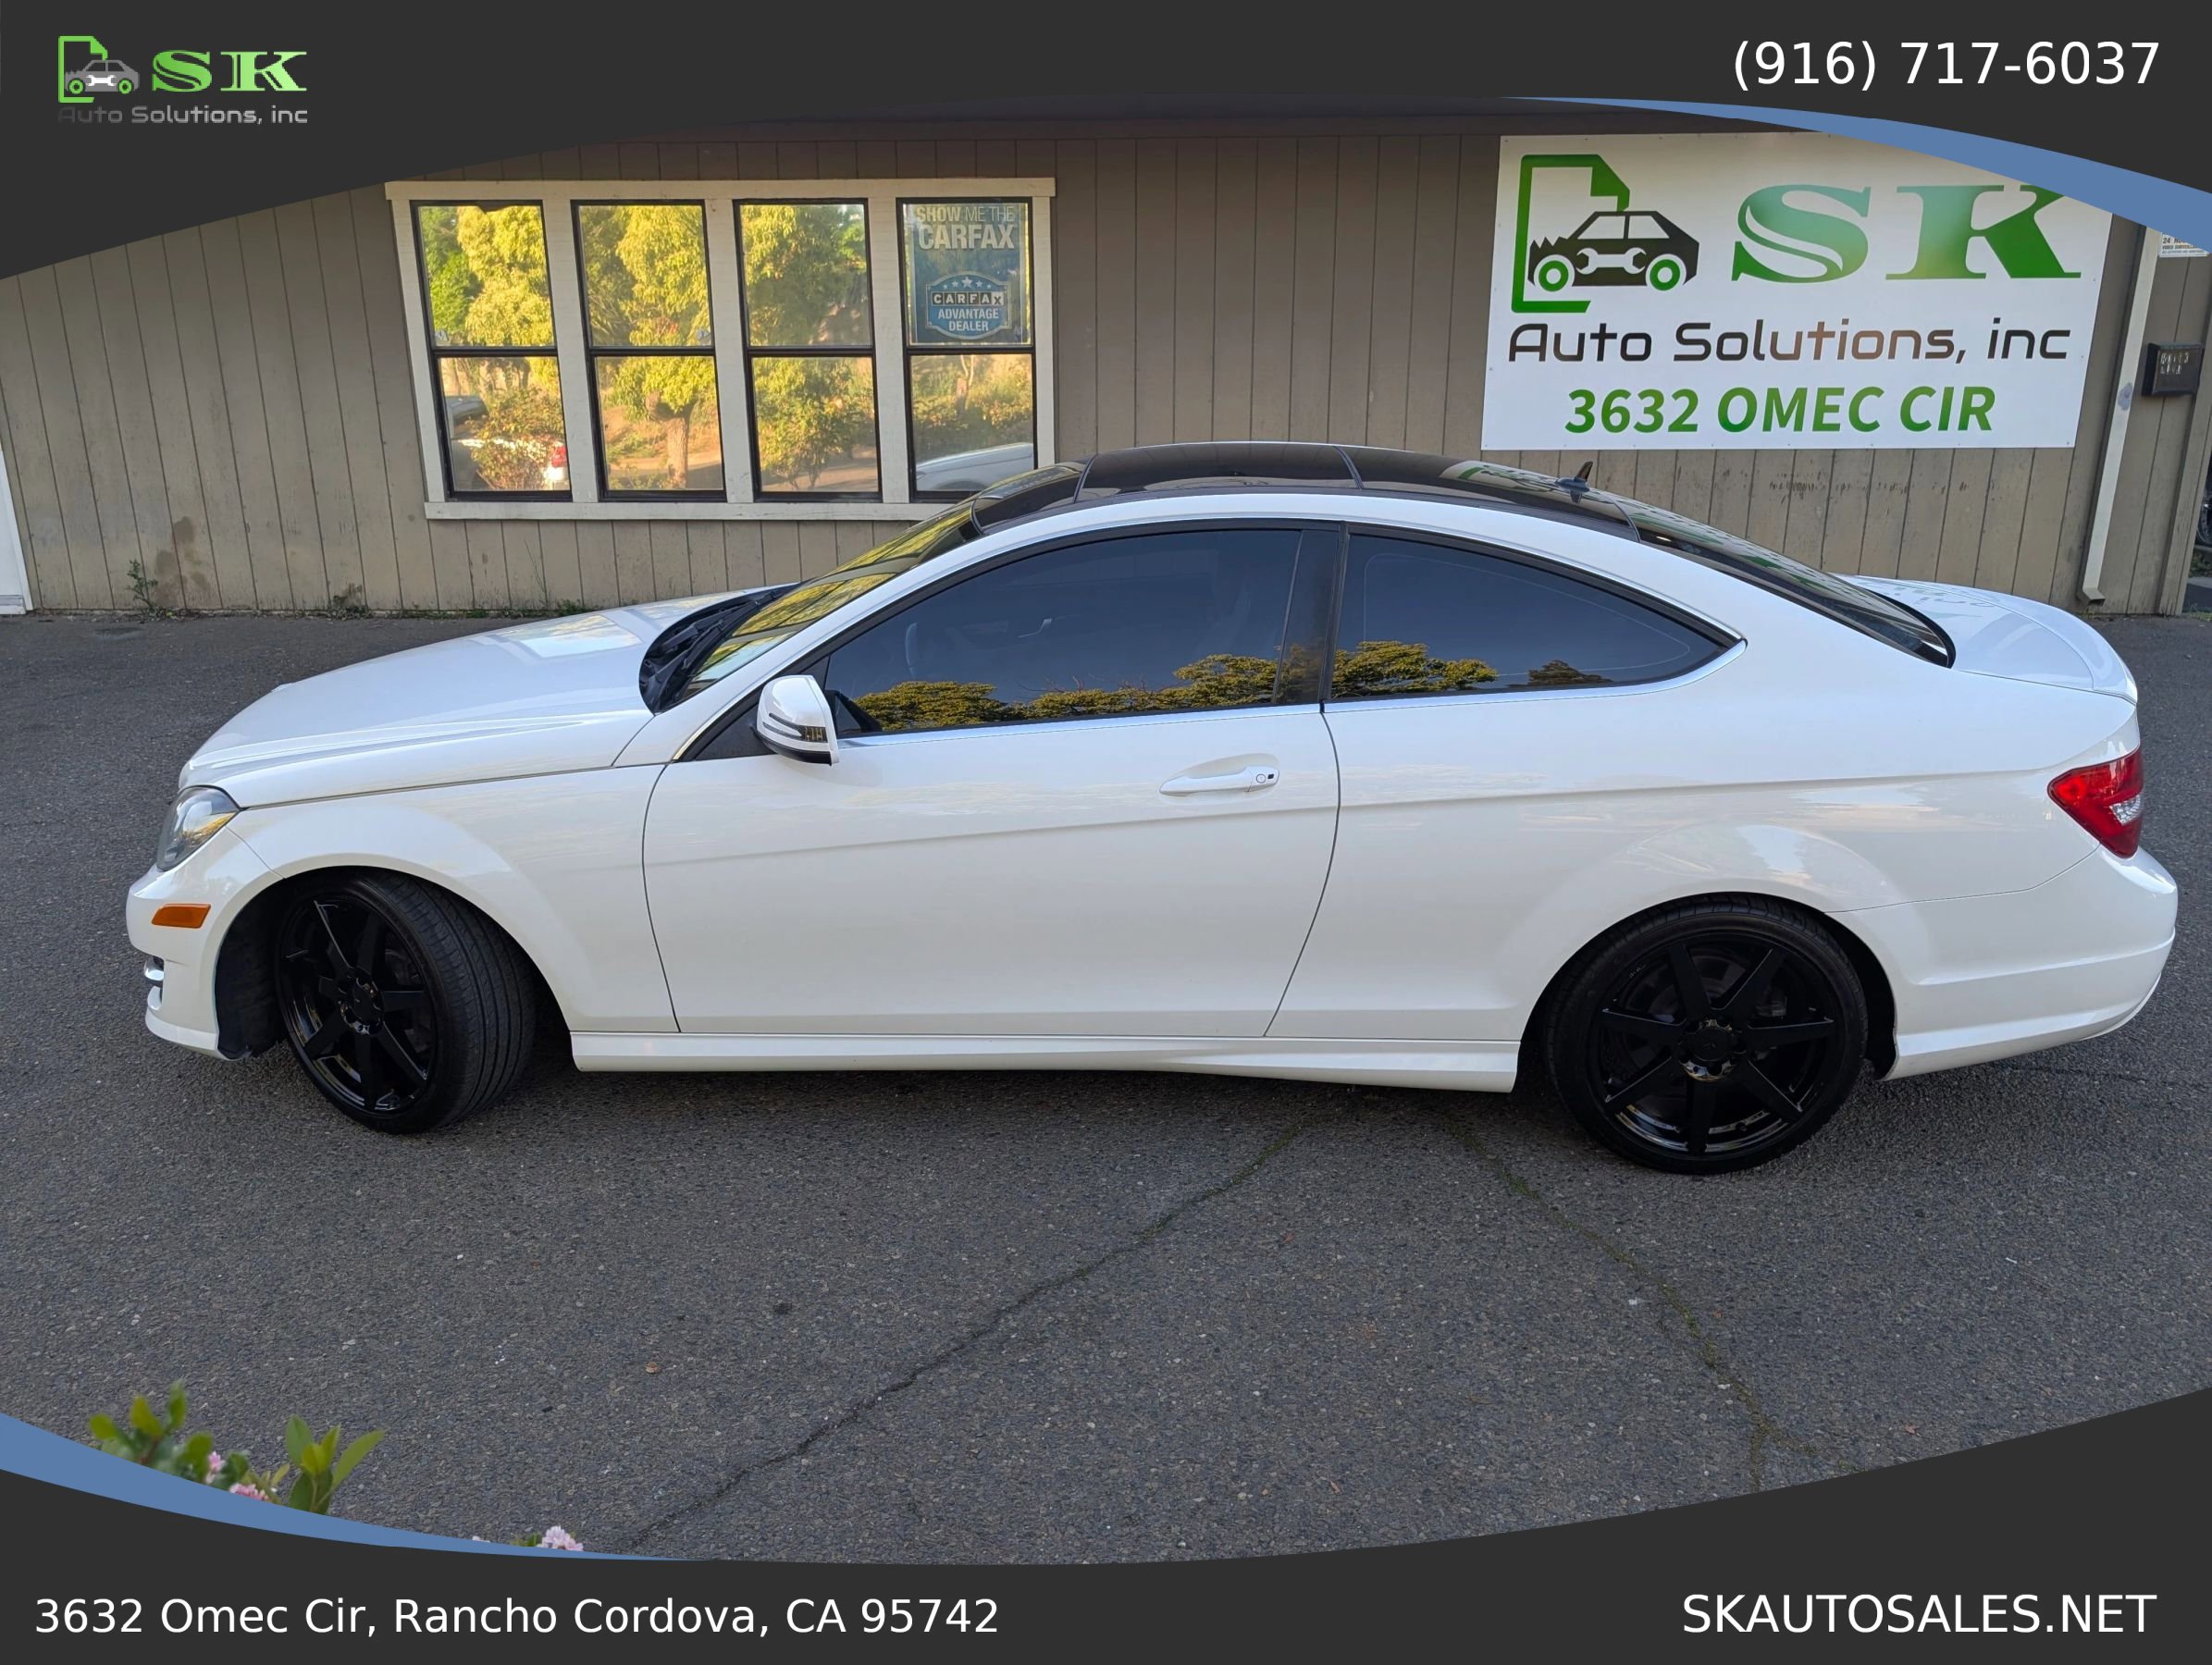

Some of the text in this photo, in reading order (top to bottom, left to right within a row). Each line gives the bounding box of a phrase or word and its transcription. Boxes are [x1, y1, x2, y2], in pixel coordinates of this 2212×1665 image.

[917, 206, 1016, 222] SHOW ME THE
[919, 224, 1015, 250] CARFAX
[1731, 184, 2082, 284] SK
[933, 293, 1003, 305] CARFAX
[938, 308, 999, 319] ADVANTAGE
[949, 321, 989, 331] DEALER
[1508, 317, 2071, 364] Auto Solutions, inc
[1564, 386, 1996, 433] 3632 OMEC CIR
